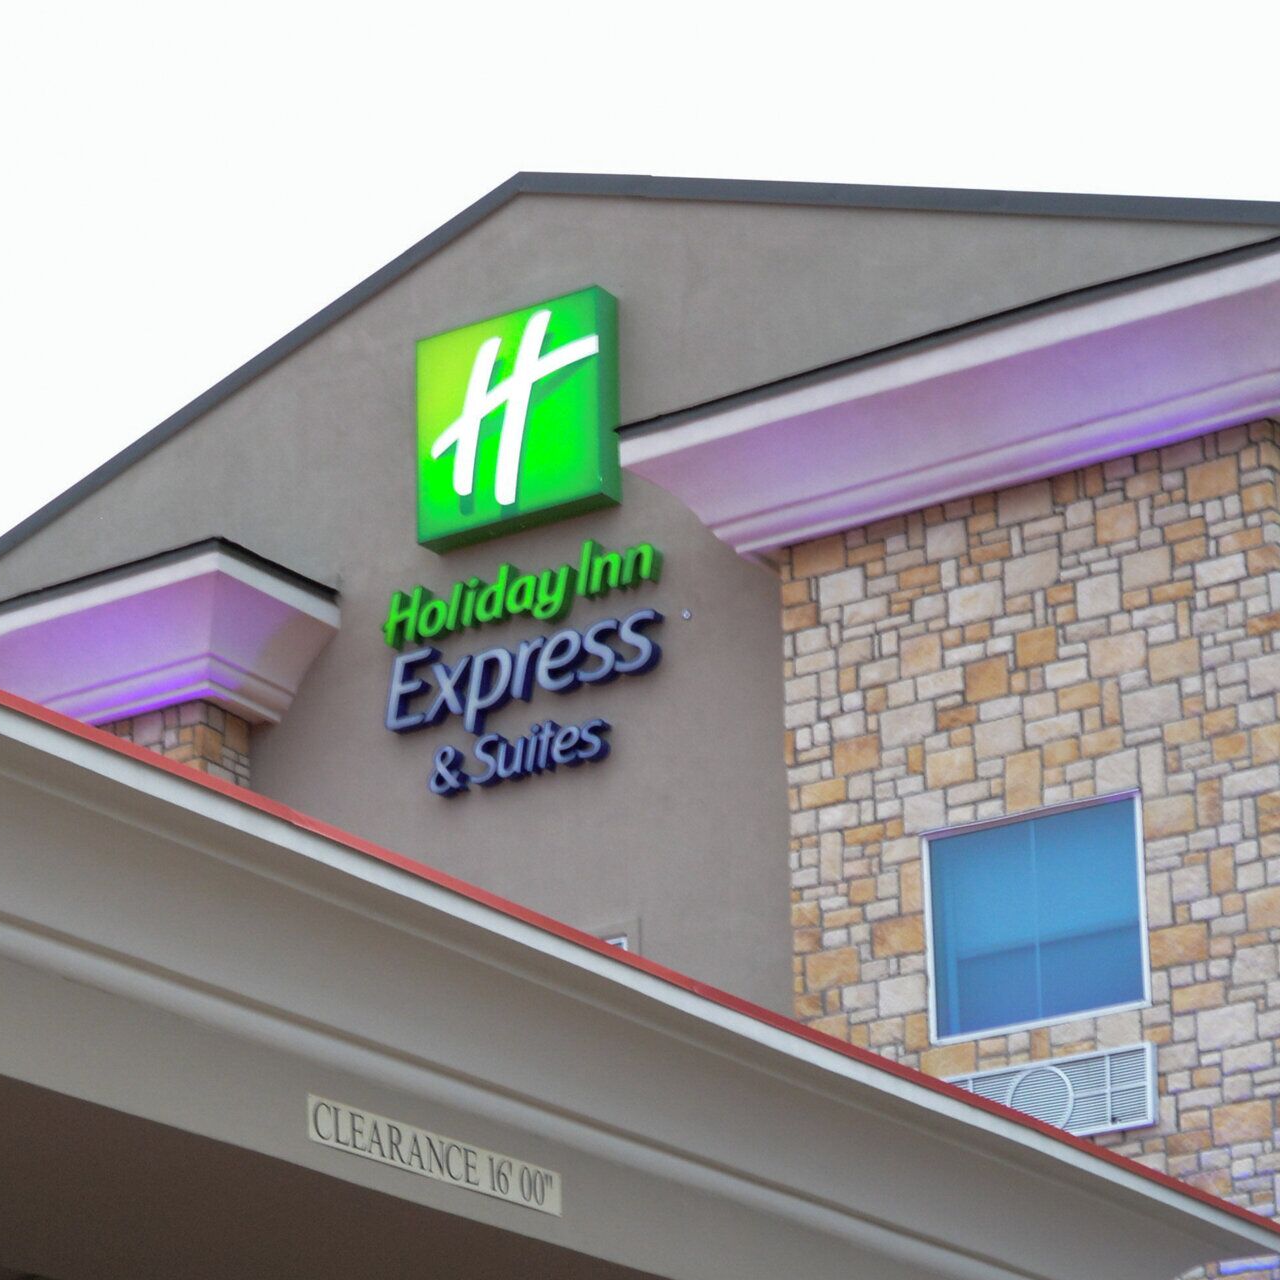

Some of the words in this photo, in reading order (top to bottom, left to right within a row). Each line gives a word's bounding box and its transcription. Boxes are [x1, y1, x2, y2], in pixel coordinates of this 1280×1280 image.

[383, 561, 576, 650] Holiday
[575, 537, 664, 599] Inn
[384, 608, 664, 735] Express
[428, 744, 468, 799] &
[468, 717, 613, 786] Suites
[313, 1101, 480, 1187] CLEARANCE
